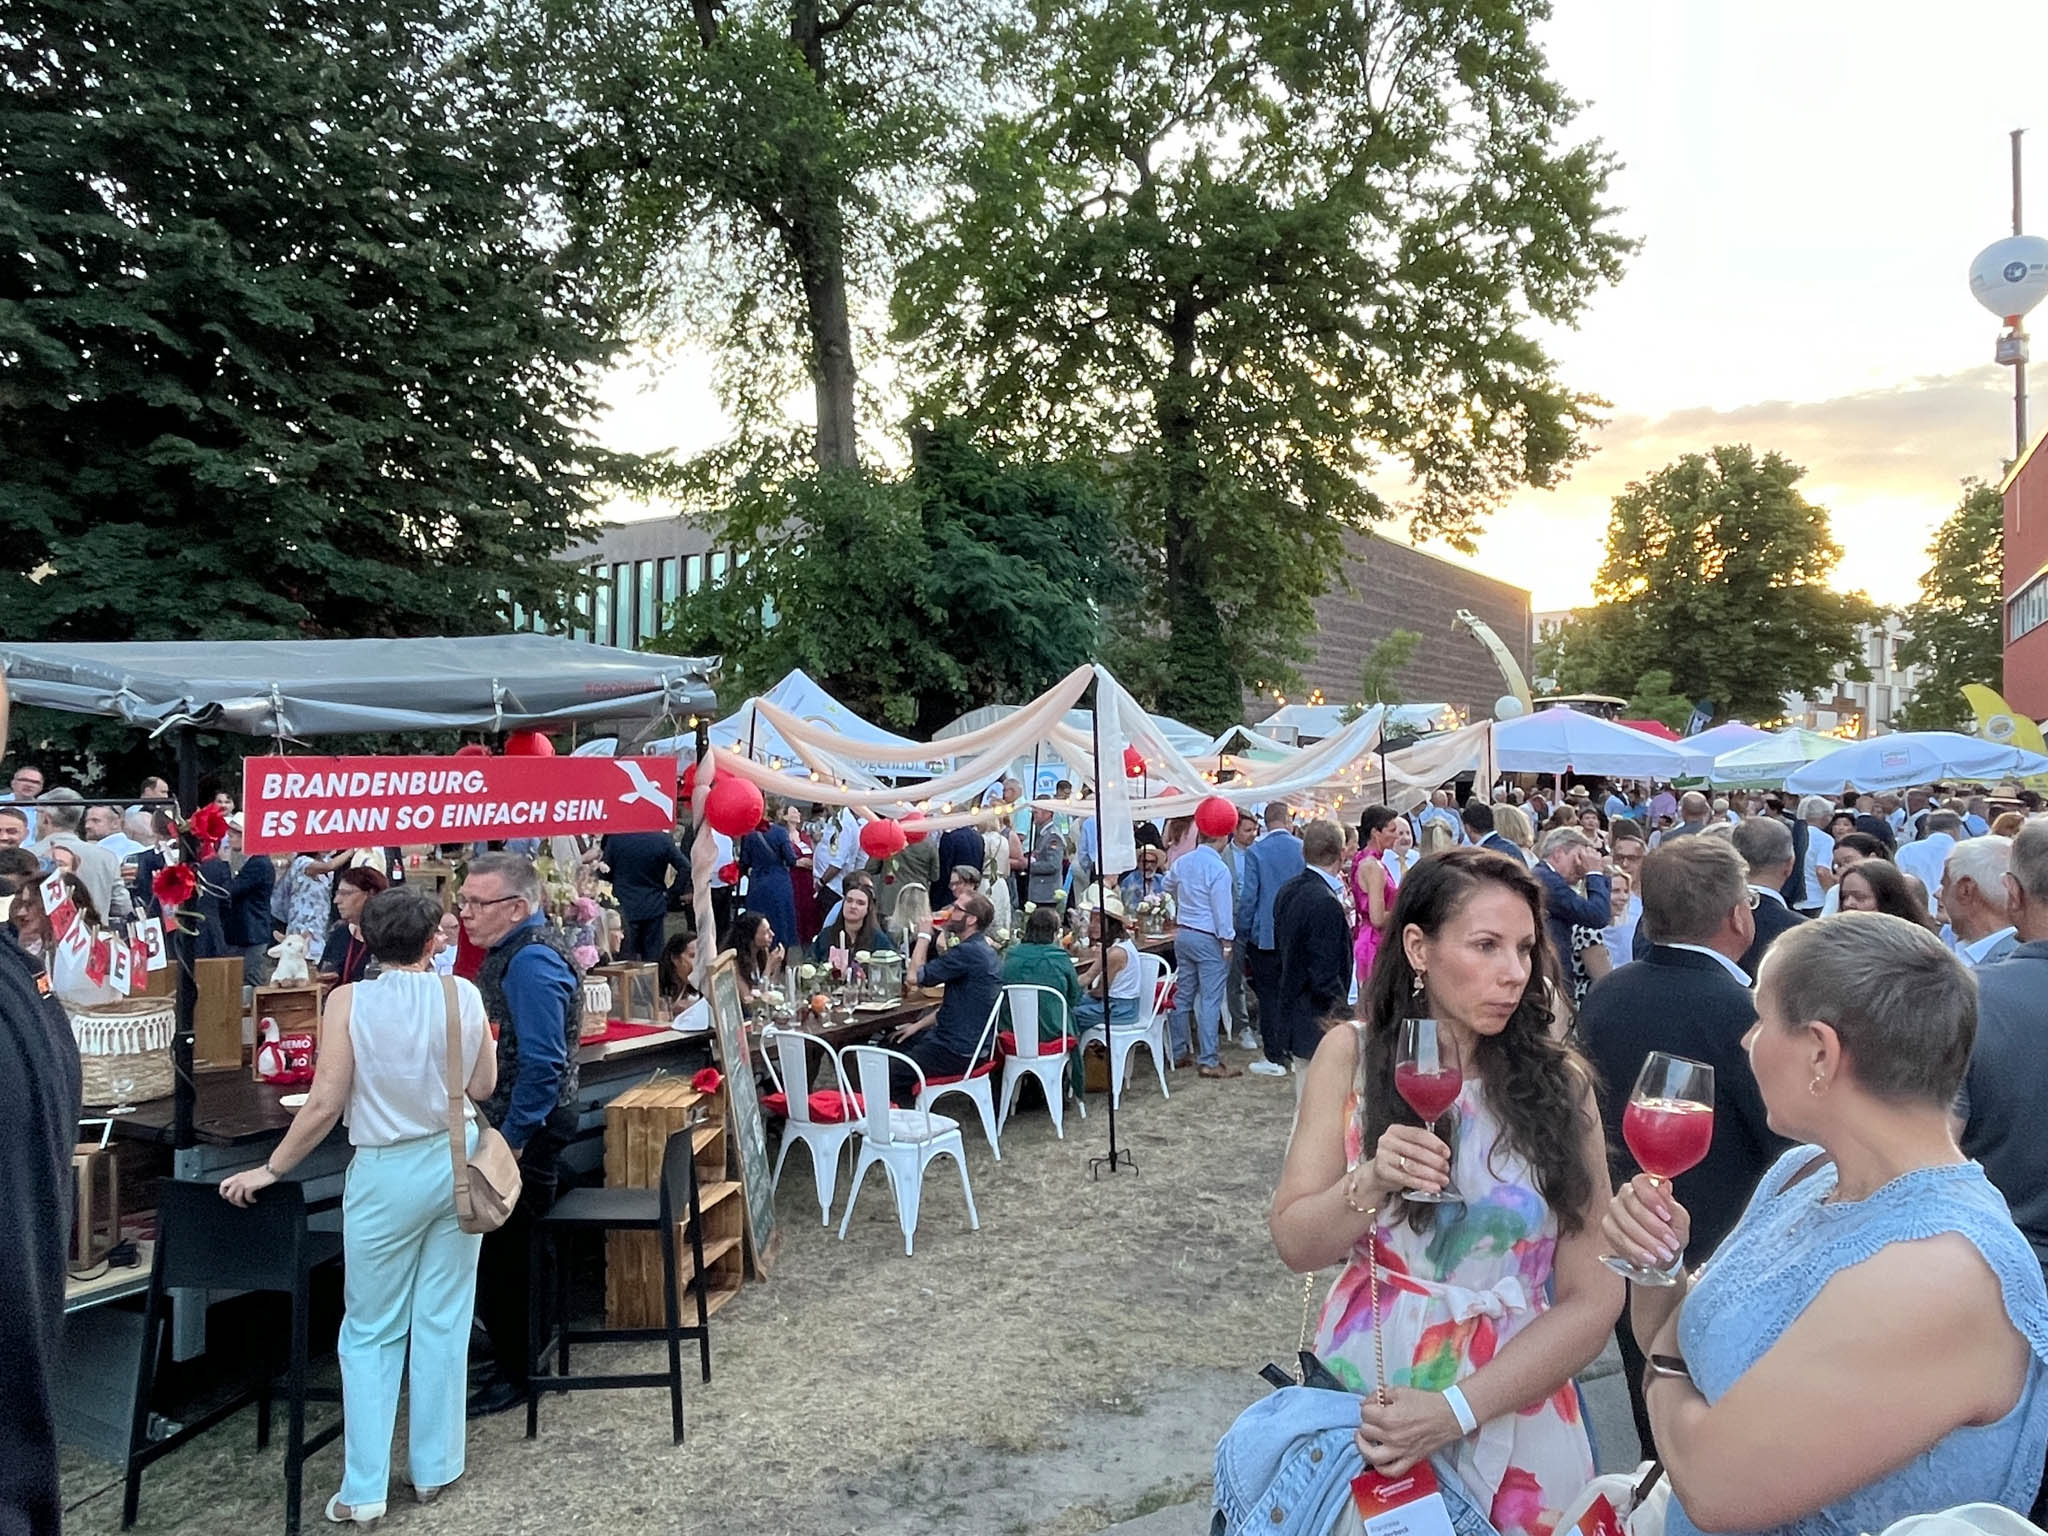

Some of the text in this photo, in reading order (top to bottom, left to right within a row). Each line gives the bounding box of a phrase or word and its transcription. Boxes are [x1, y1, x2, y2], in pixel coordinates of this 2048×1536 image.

[261, 770, 488, 799] BRANDENBURG.
[261, 799, 608, 837] ES KANN SO EINFACH SEIN.
